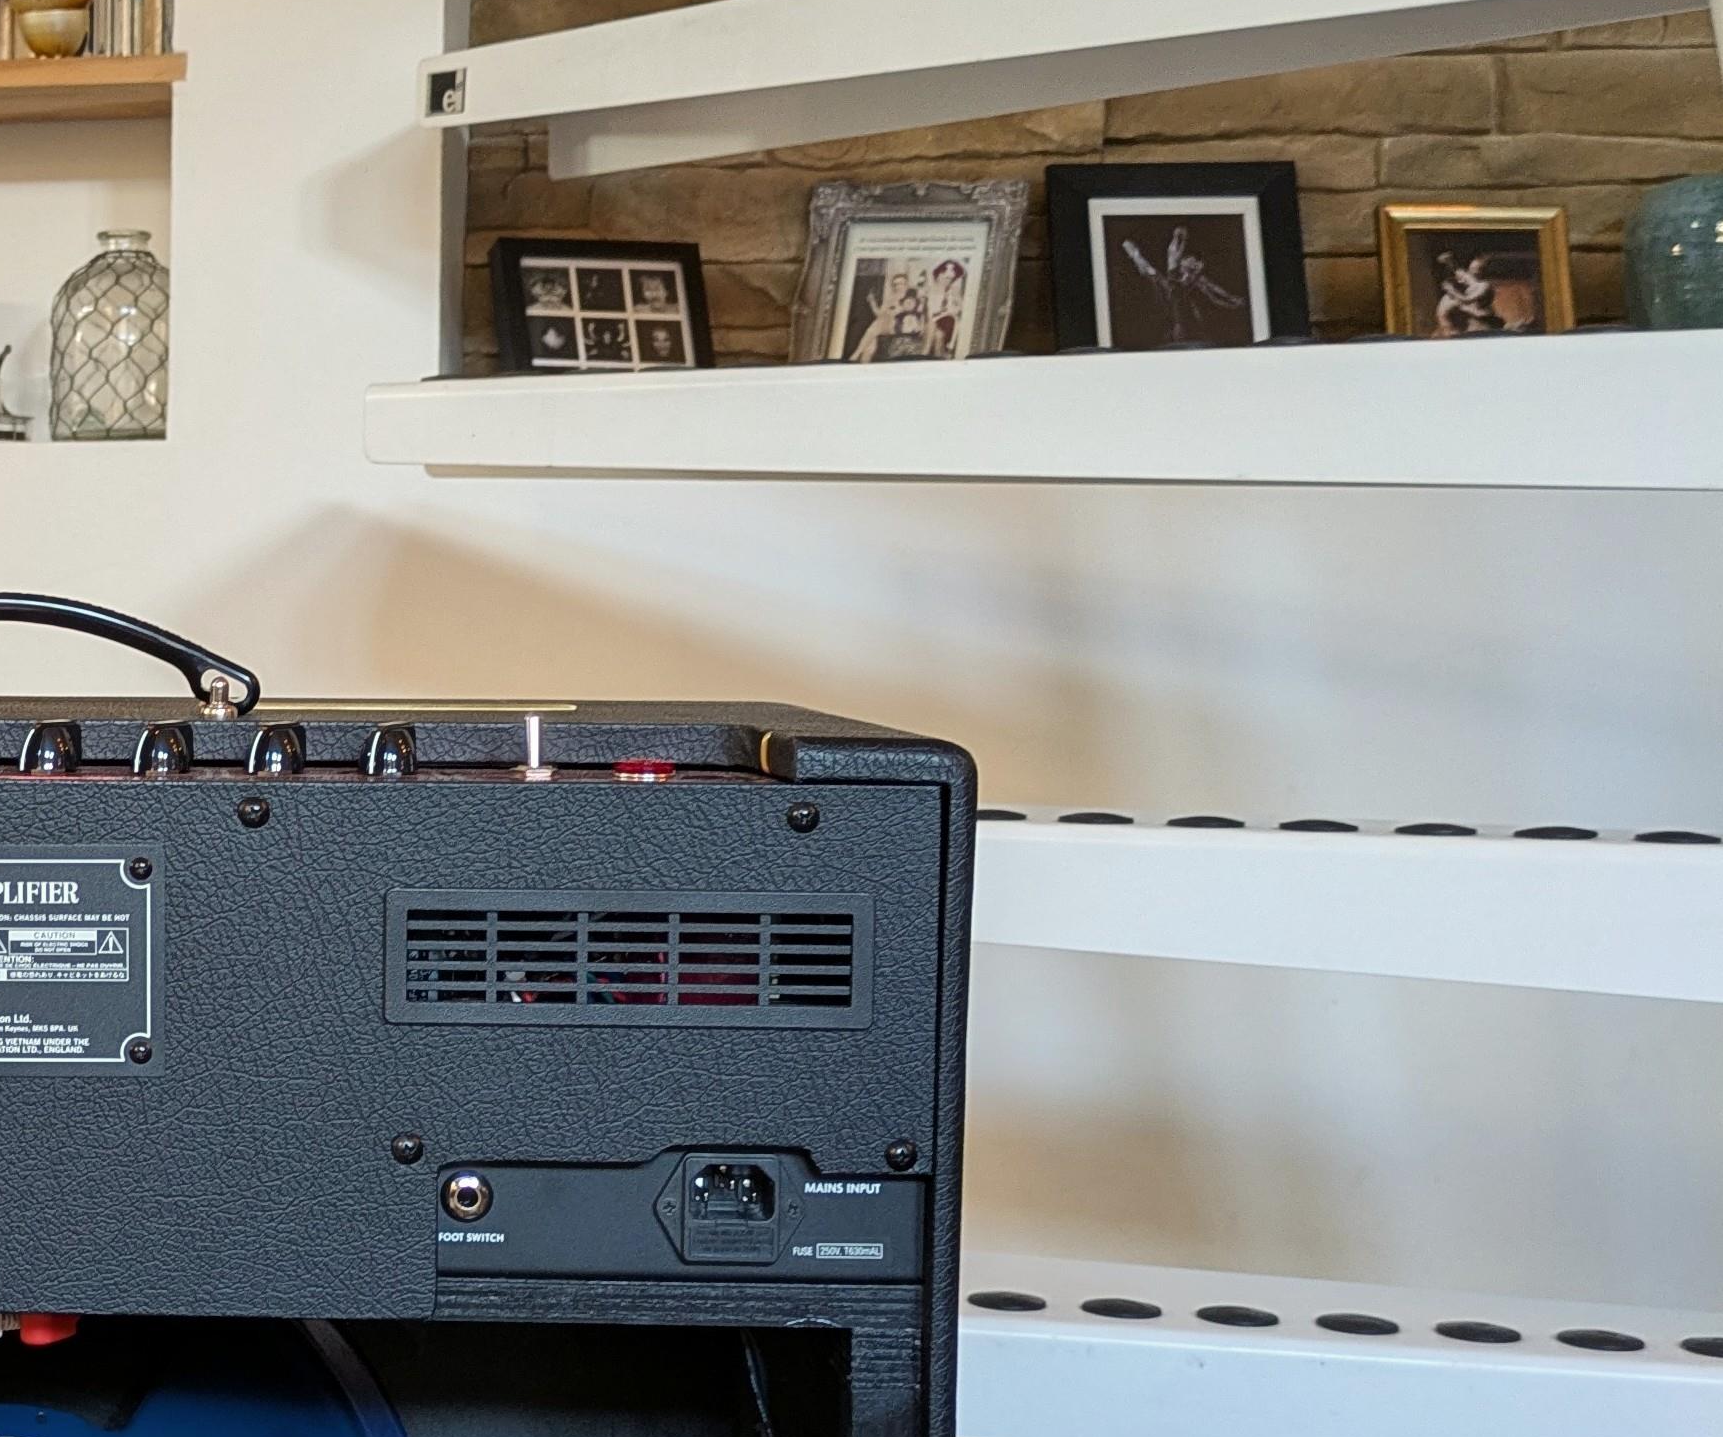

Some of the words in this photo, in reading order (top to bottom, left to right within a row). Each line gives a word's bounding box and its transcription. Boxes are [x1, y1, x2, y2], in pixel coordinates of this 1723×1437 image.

[84, 914, 100, 922] MAY
[101, 914, 113, 922] BE
[33, 931, 76, 940] CAUTION
[13, 1014, 32, 1023] Ltd.
[5, 1037, 41, 1046] VIETNAM
[43, 1038, 71, 1046] UNDER
[73, 1038, 90, 1046] THE
[804, 1183, 843, 1194] MAINS
[847, 1183, 881, 1195] INPUT
[438, 1232, 466, 1242] FOOT
[467, 1232, 505, 1243] SWITCH
[792, 1246, 813, 1256] FUSE
